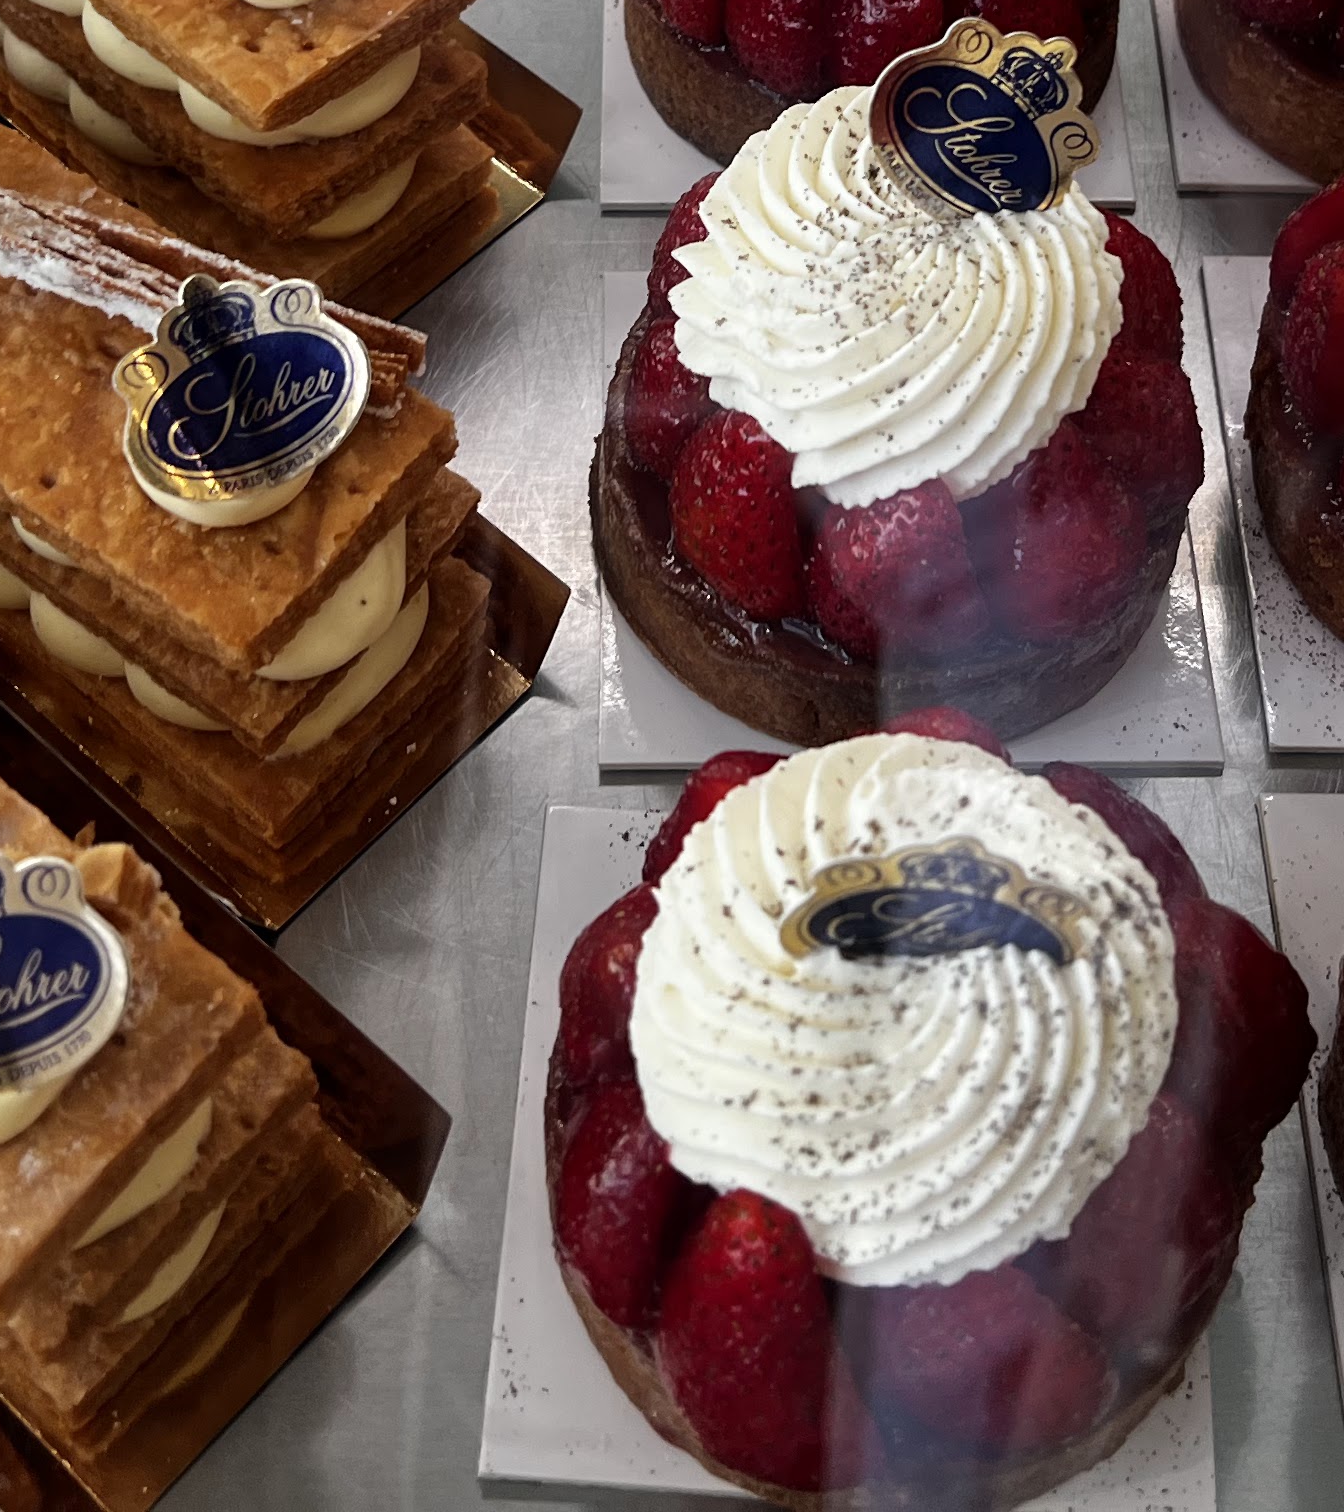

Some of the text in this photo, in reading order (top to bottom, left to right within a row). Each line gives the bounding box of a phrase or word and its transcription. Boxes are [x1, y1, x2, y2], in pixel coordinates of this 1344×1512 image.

[904, 82, 1023, 205] Stohrer
[167, 353, 336, 460] Stohrer
[224, 475, 263, 493] PARIS
[267, 452, 313, 481] DEPUIS
[10, 1053, 62, 1084] DEPUIS
